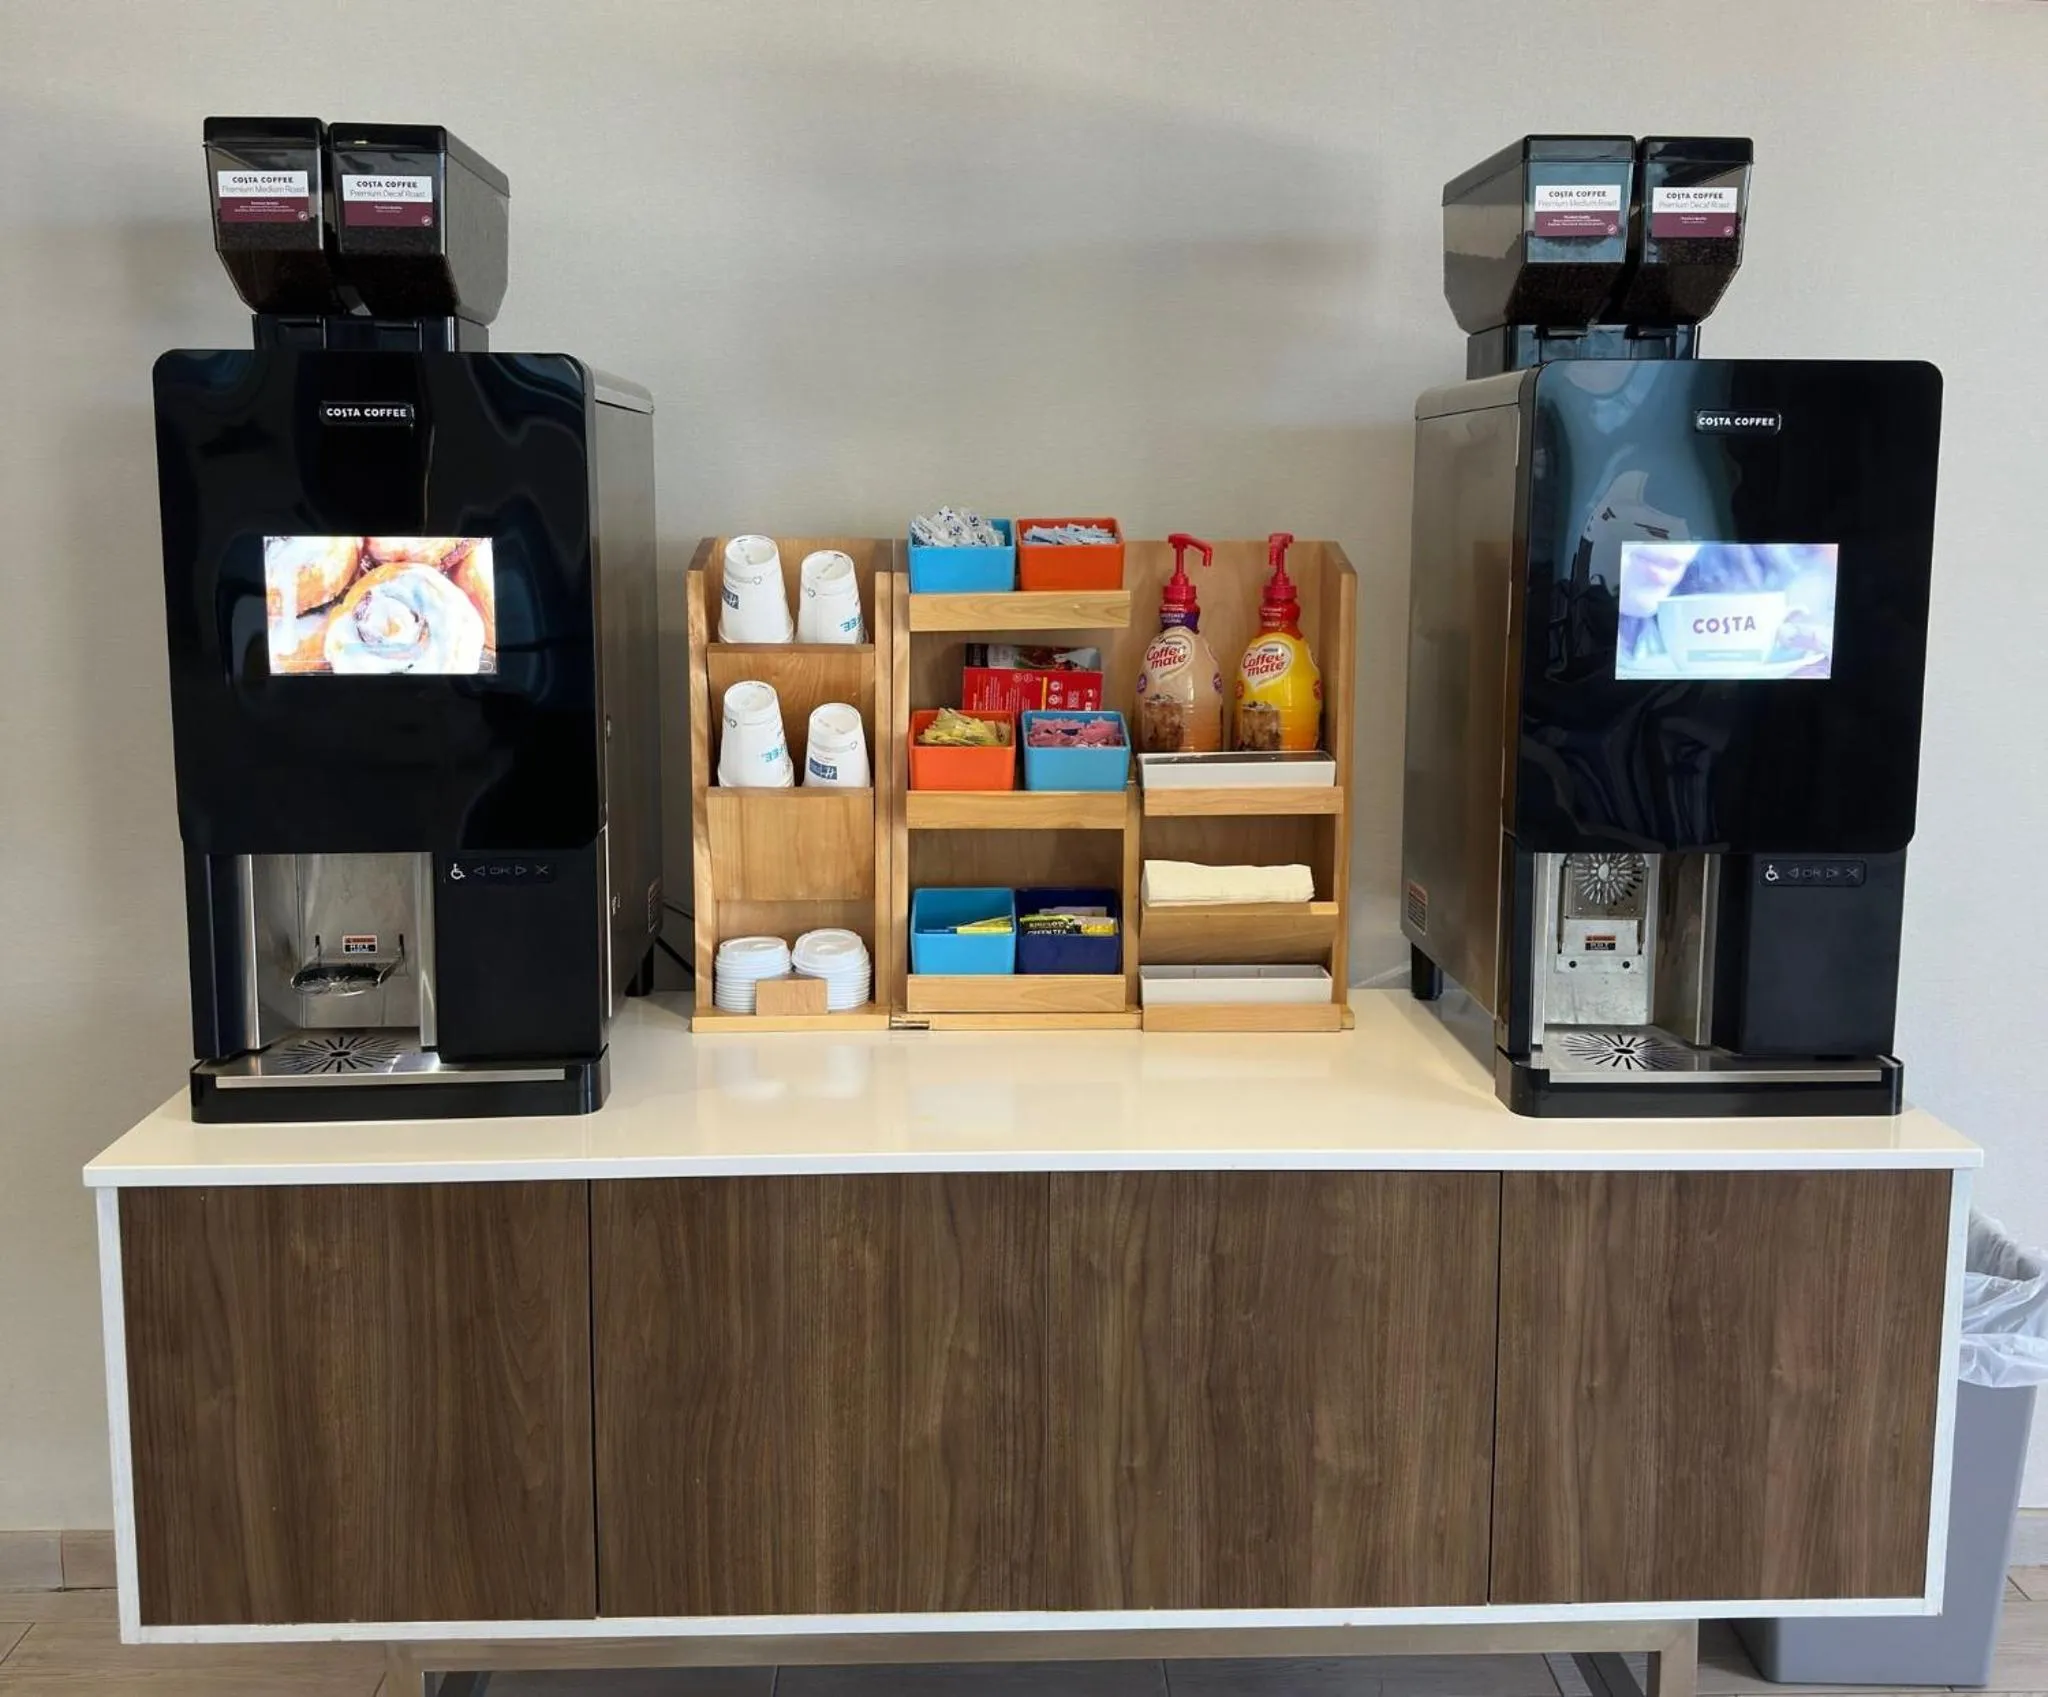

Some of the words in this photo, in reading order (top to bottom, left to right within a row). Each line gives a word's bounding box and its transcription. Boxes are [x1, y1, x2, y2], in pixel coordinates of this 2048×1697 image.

[231, 176, 258, 184] COSTA
[260, 176, 294, 184] COFFEE
[356, 181, 383, 189] COSTA
[222, 185, 254, 194] Premium
[255, 185, 284, 193] Medium
[1548, 190, 1574, 198] COSTA
[1576, 190, 1607, 198] COFFEE
[1666, 192, 1691, 200] COSTA
[326, 408, 361, 418] COSTA
[364, 408, 407, 417] COFFEE
[1699, 417, 1731, 427] COSTA
[1734, 417, 1775, 426] COFFEE
[1692, 615, 1756, 634] COSTA
[1150, 653, 1186, 670] mate
[1242, 653, 1285, 669] Coffee
[1247, 661, 1285, 677] mate
